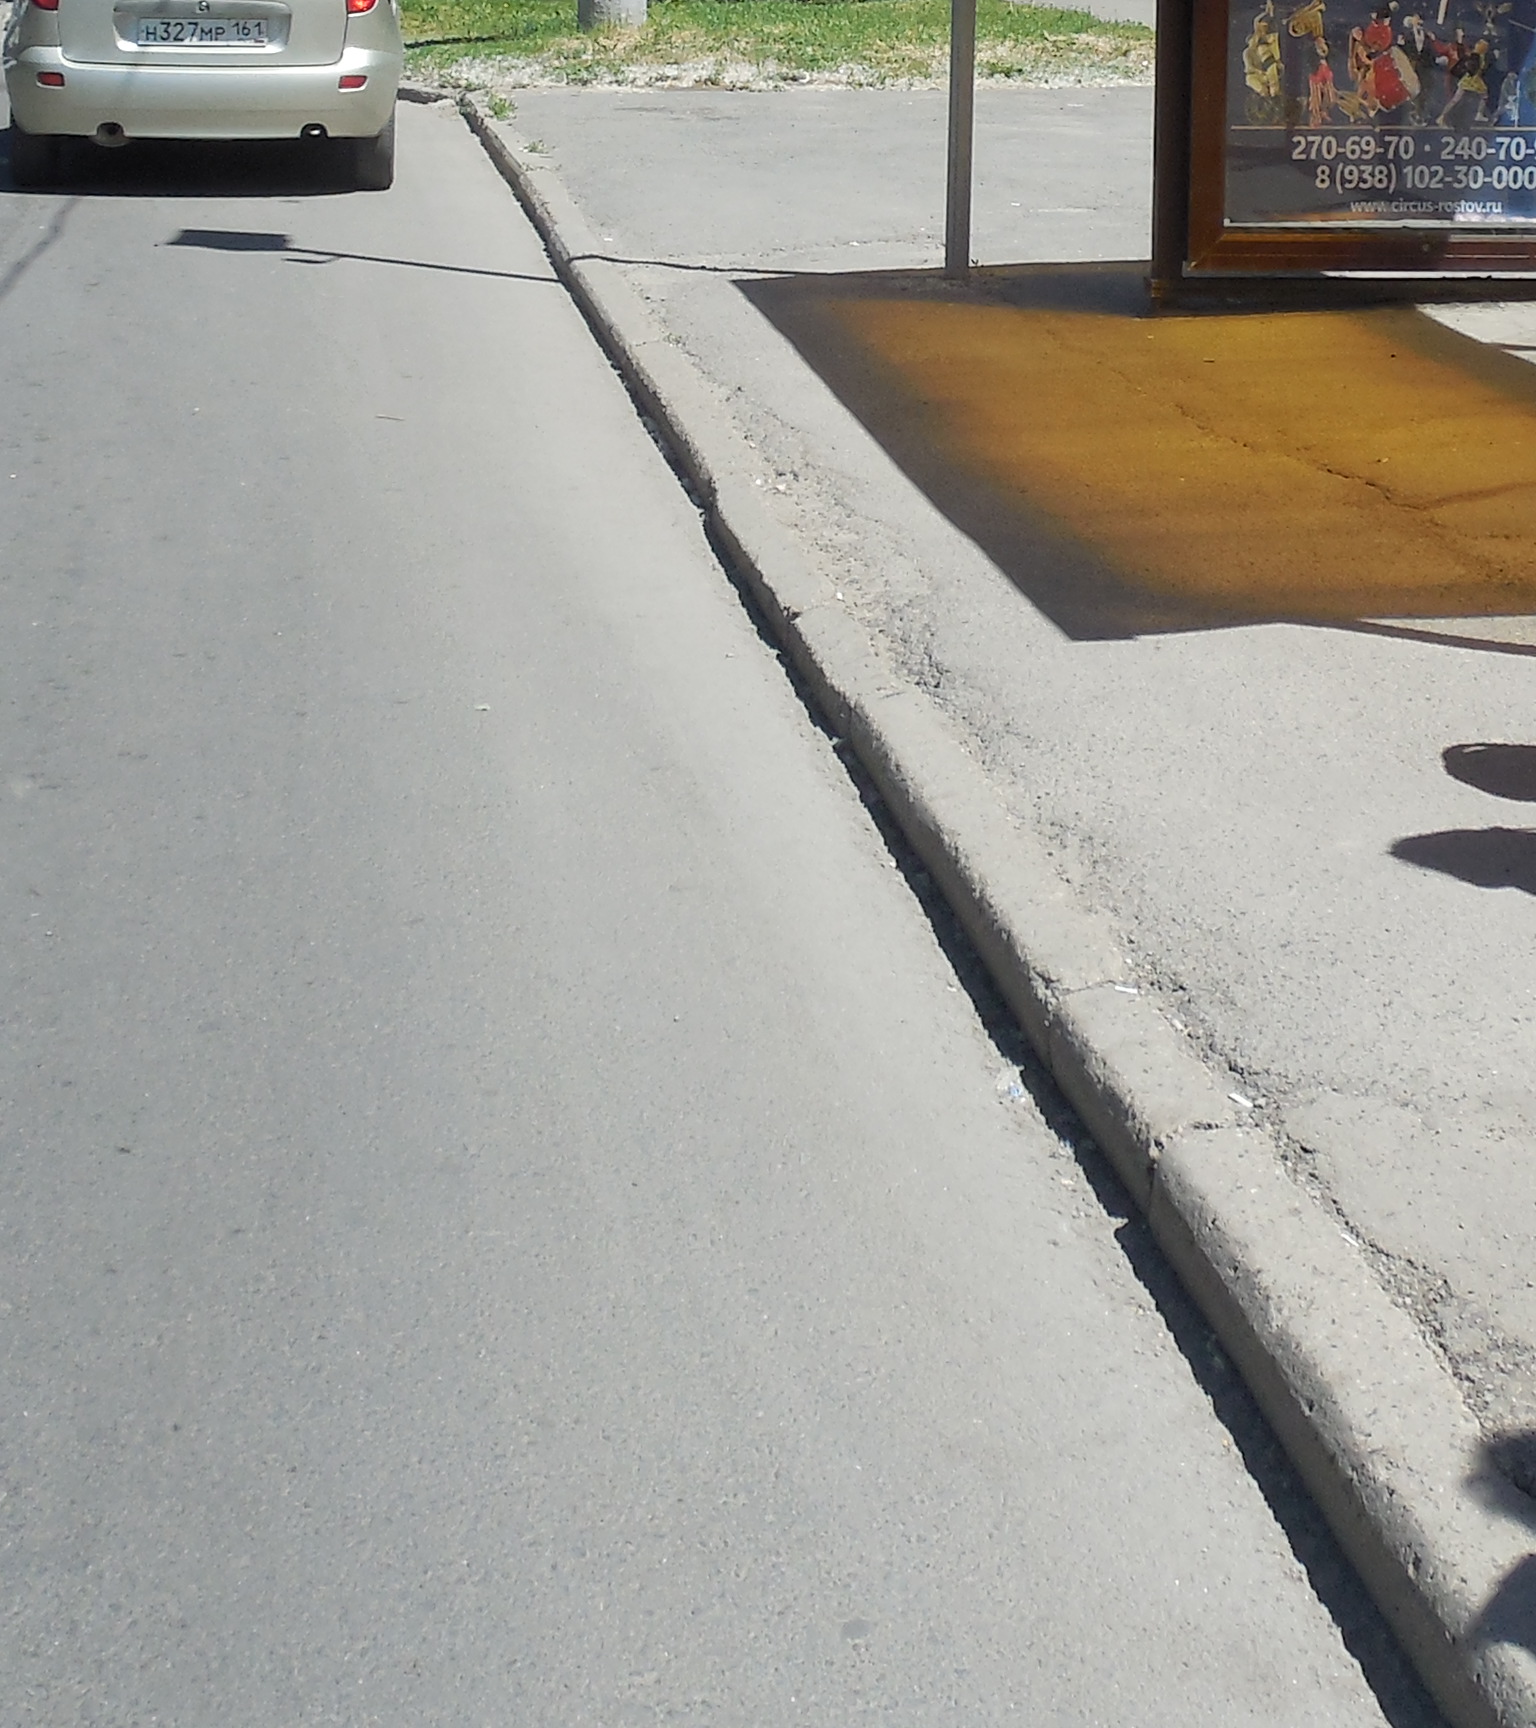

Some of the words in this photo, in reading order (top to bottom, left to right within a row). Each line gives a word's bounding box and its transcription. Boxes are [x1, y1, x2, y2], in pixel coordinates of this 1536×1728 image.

[232, 22, 263, 37] 161
[1291, 135, 1415, 161] 270-69-70
[1314, 165, 1330, 189] 8
[1334, 161, 1396, 194] (938)
